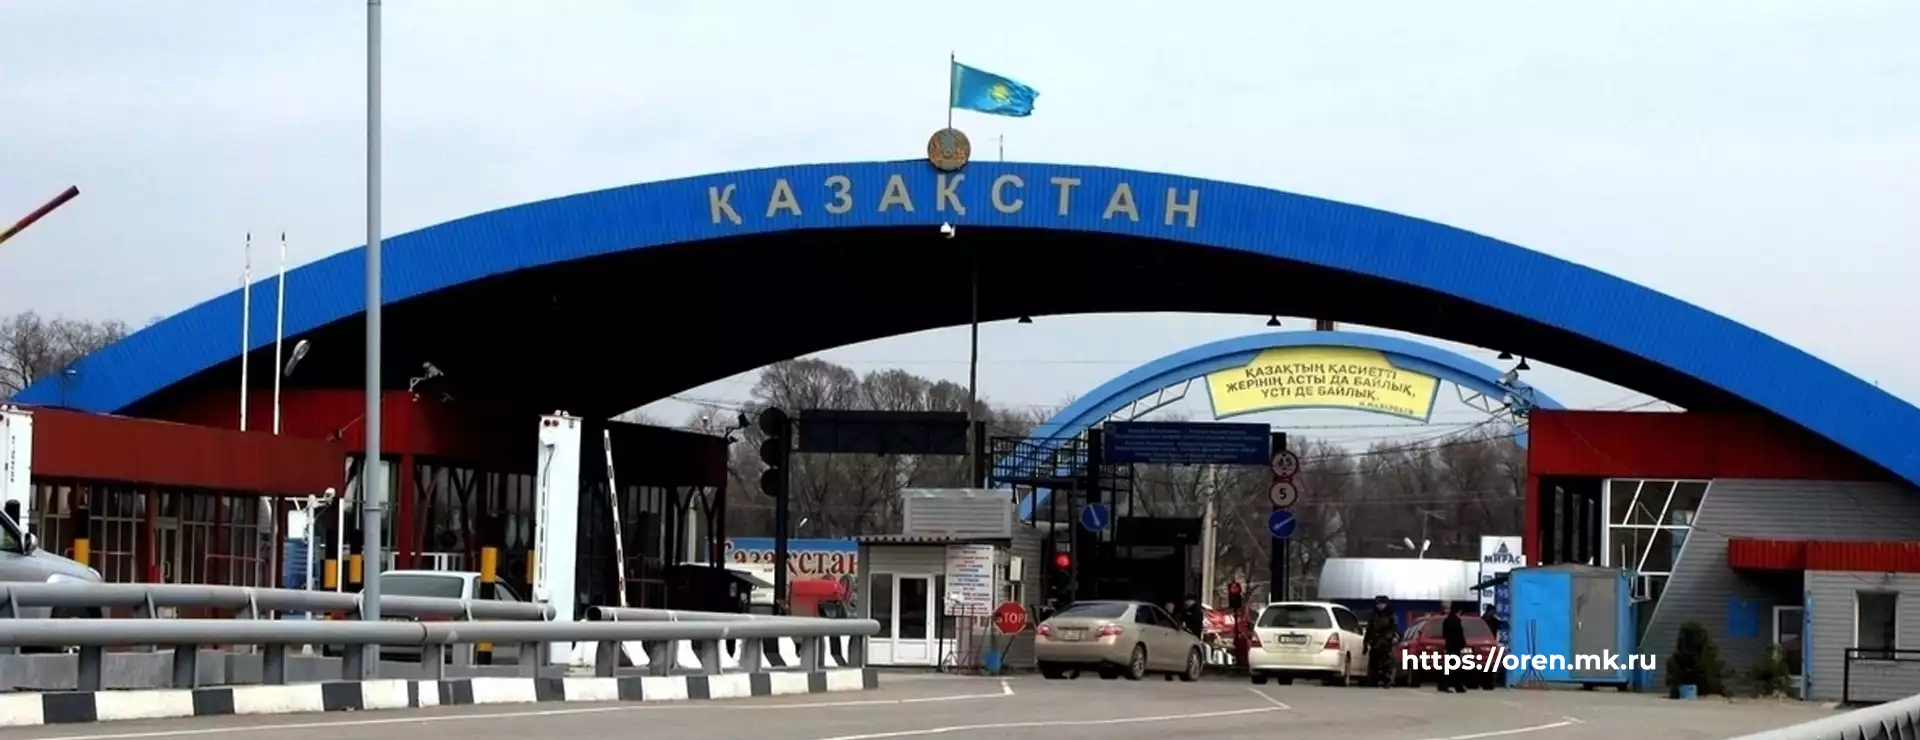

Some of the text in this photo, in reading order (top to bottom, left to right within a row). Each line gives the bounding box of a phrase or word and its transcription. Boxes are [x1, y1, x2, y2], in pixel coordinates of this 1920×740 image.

[708, 174, 1199, 228] ҚАЗАҚСТАН
[1287, 375, 1326, 385] АСТЫ
[1330, 376, 1349, 387] ДА
[1294, 387, 1314, 398] ДЕ
[1280, 487, 1287, 500] 5
[1484, 554, 1520, 564] МИРАС
[996, 612, 1025, 624] STOP
